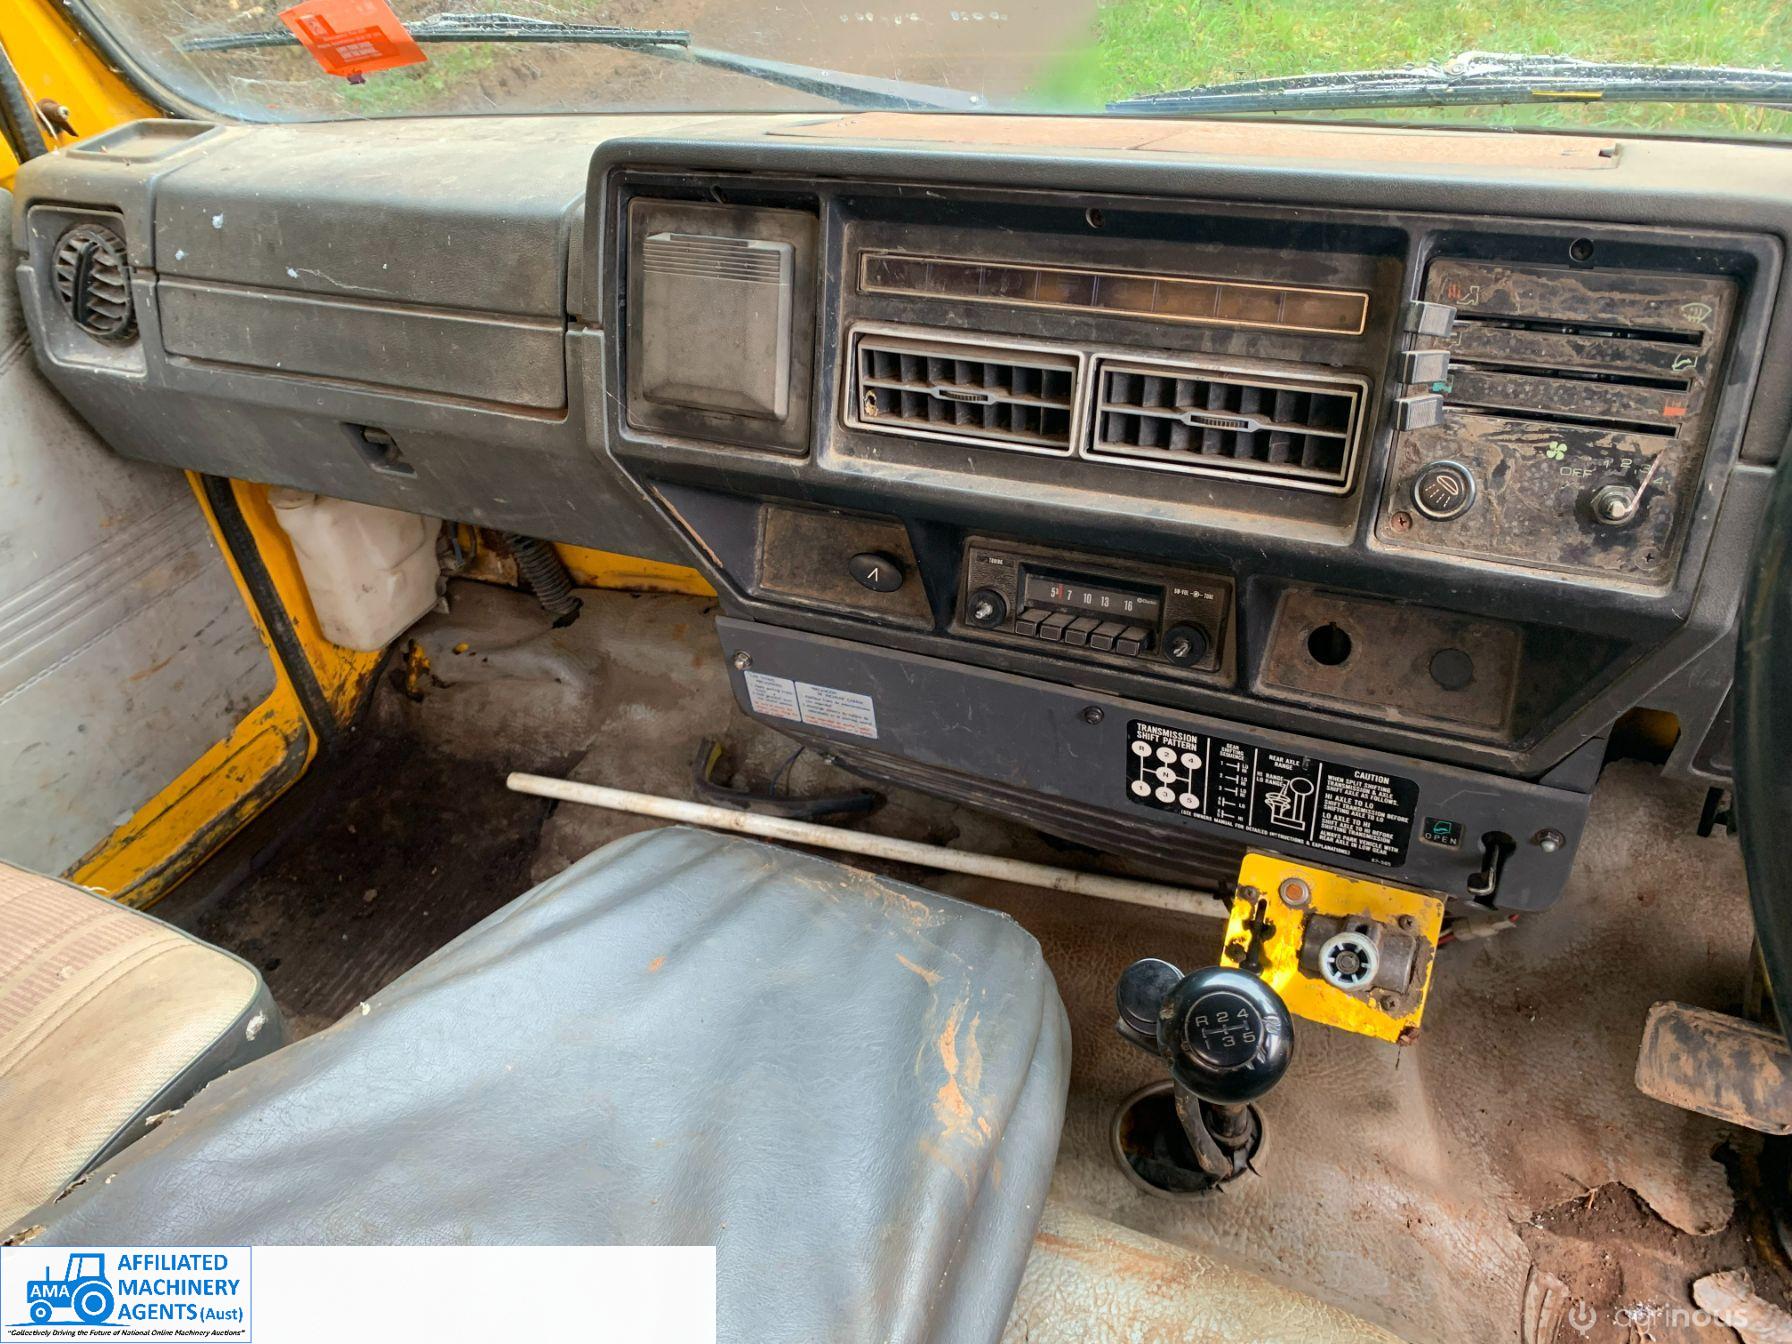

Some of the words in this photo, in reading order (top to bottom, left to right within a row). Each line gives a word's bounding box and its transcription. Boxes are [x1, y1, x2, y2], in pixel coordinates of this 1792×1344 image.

[1560, 466, 1593, 478] OFF
[1066, 589, 1072, 601] 7
[1083, 593, 1092, 604] 10
[1101, 596, 1109, 607] 13
[1124, 600, 1133, 611] 16
[1137, 722, 1198, 743] TRANSMISSION
[1136, 731, 1159, 742] SHIFT
[1163, 737, 1197, 751] PATTERN
[1269, 754, 1283, 762] REAR
[1274, 762, 1293, 770] RANGE
[1265, 779, 1283, 787] RANGE
[1266, 773, 1284, 781] RANGE
[1328, 775, 1344, 783] WHEN
[1346, 779, 1362, 787] SPLIT
[1364, 783, 1391, 793] SHIFTING
[1354, 770, 1390, 784] CAUTION
[1326, 785, 1343, 793] SHIFT
[1344, 789, 1359, 797] AXLE
[1328, 780, 1370, 794] TRANSMISSION
[1378, 791, 1393, 799] AXLE
[1335, 795, 1352, 804] AXLE
[1324, 804, 1349, 815] SHIFTING
[1324, 799, 1341, 807] SHIFT
[1343, 804, 1385, 818] TRANSMISSION
[1387, 813, 1409, 823] BEFORE
[1333, 814, 1350, 823] AXLE
[1193, 812, 1212, 821] OWNERS
[1214, 818, 1233, 827] MANUAL
[1246, 826, 1268, 835] DETAILED
[1269, 832, 1304, 844] INSTRUCTIONS
[1321, 823, 1347, 834] SHIFTING
[1349, 829, 1391, 844] TRANSMISSION
[1322, 818, 1338, 826] SHIFT
[1340, 822, 1354, 830] AXLE
[1372, 830, 1394, 840] BEFORE
[1320, 830, 1341, 839] ALWAYS
[1360, 839, 1382, 849] VEHICLE
[1384, 845, 1399, 853] WITH
[1425, 833, 1457, 845] OPEN
[1195, 1016, 1209, 1027] R
[1216, 1012, 1229, 1022] 2
[1237, 1008, 1249, 1018] 4
[1222, 1035, 1236, 1047] 3
[1243, 1032, 1256, 1043] 5
